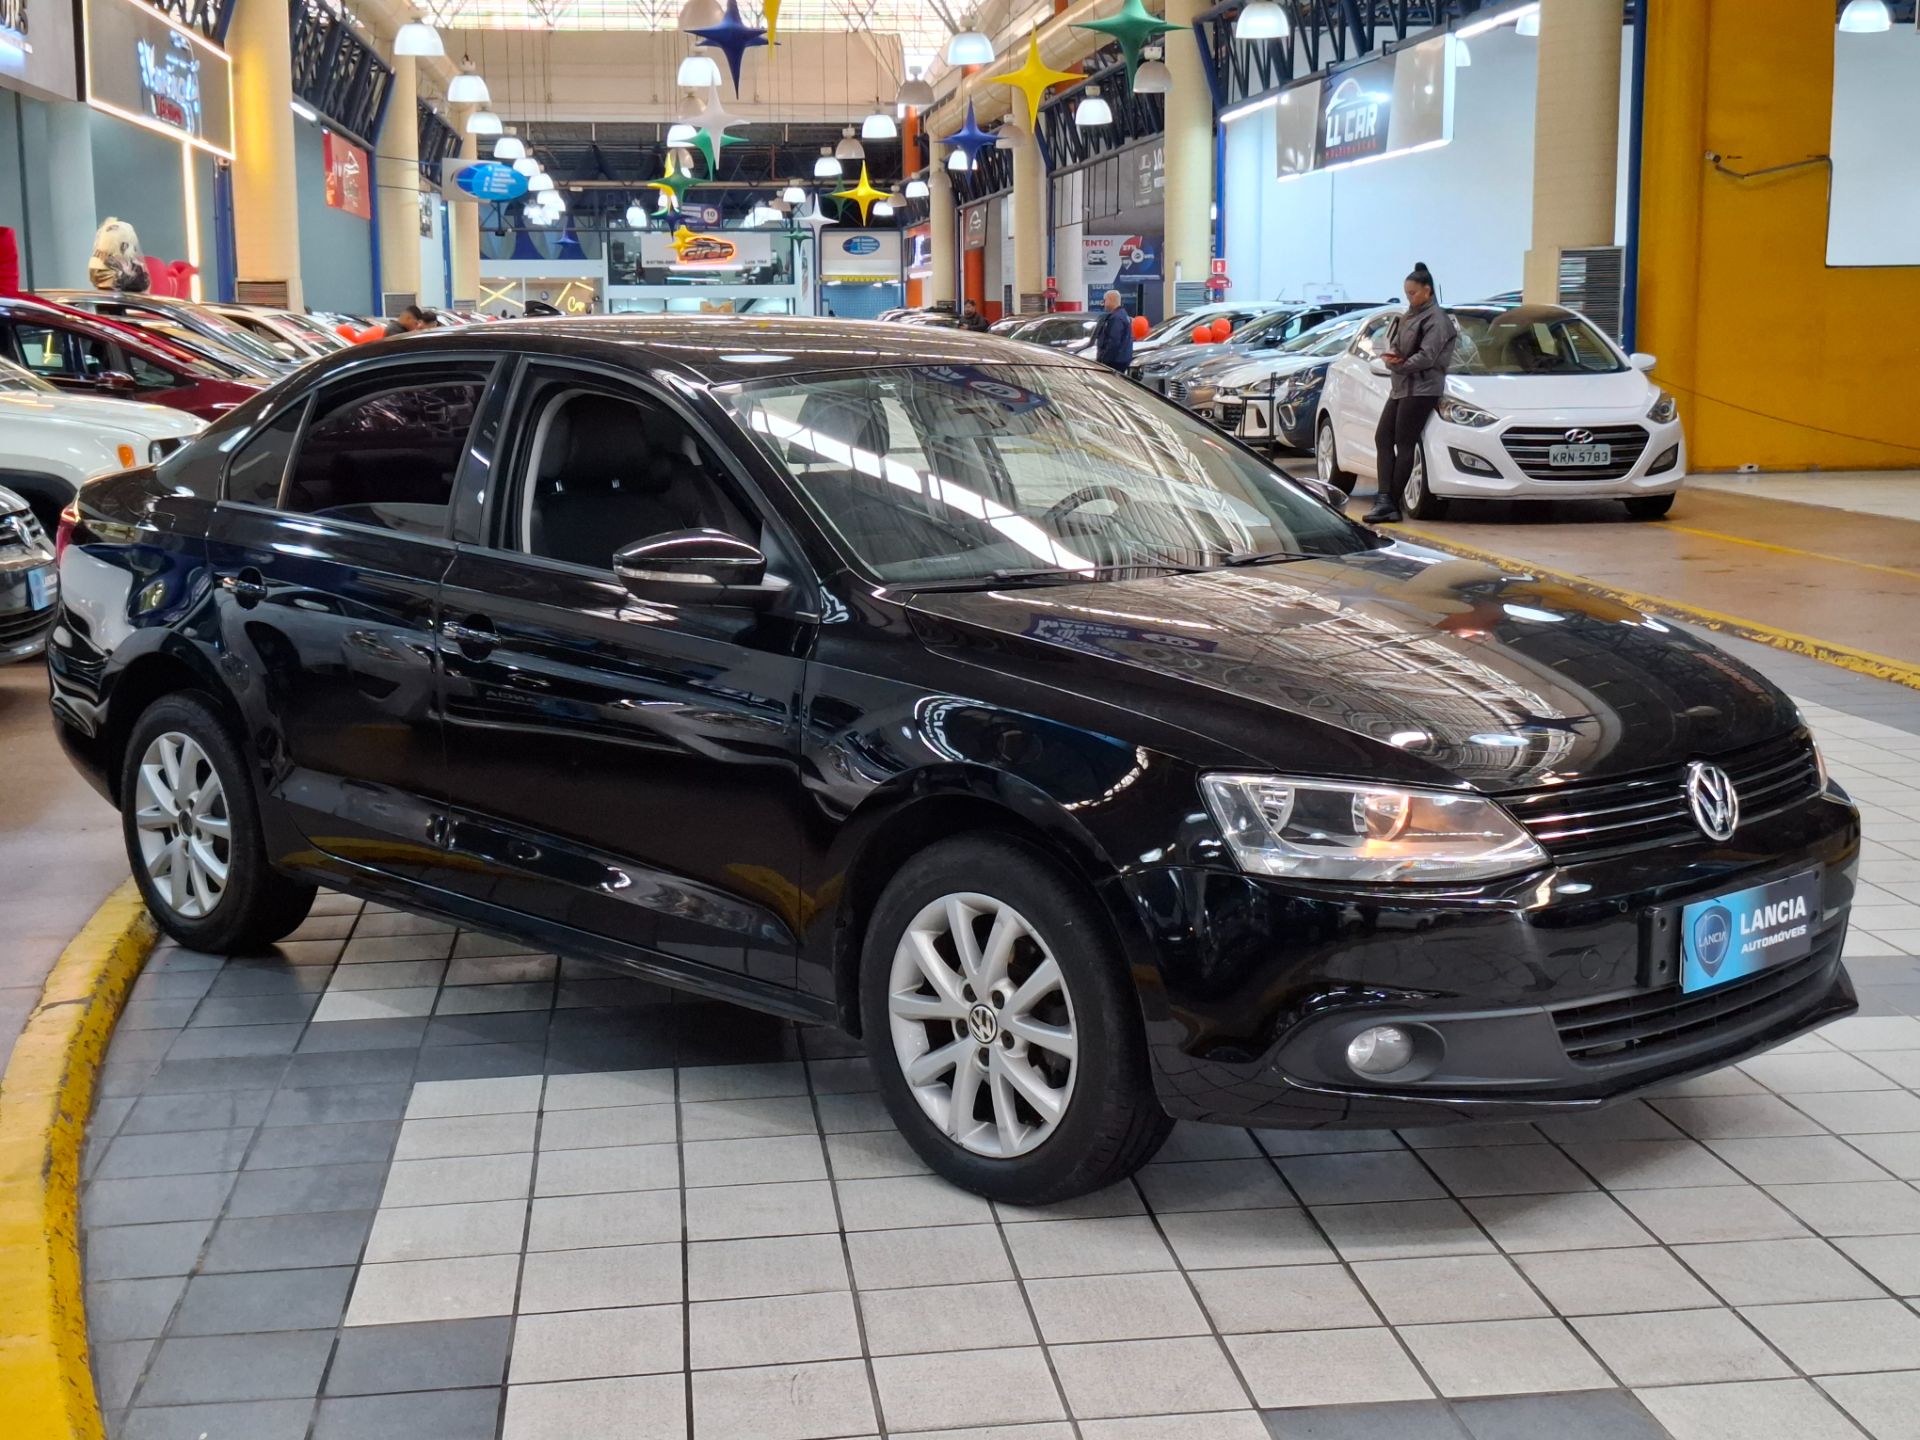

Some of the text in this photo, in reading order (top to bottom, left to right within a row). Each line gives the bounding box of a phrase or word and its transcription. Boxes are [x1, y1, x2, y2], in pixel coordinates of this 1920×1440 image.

[1325, 103, 1378, 148] LL CAR
[1740, 895, 1807, 936] LANCIA
[1698, 930, 1728, 948] LANCIA
[1740, 924, 1807, 954] AUTOMÓVEIS
